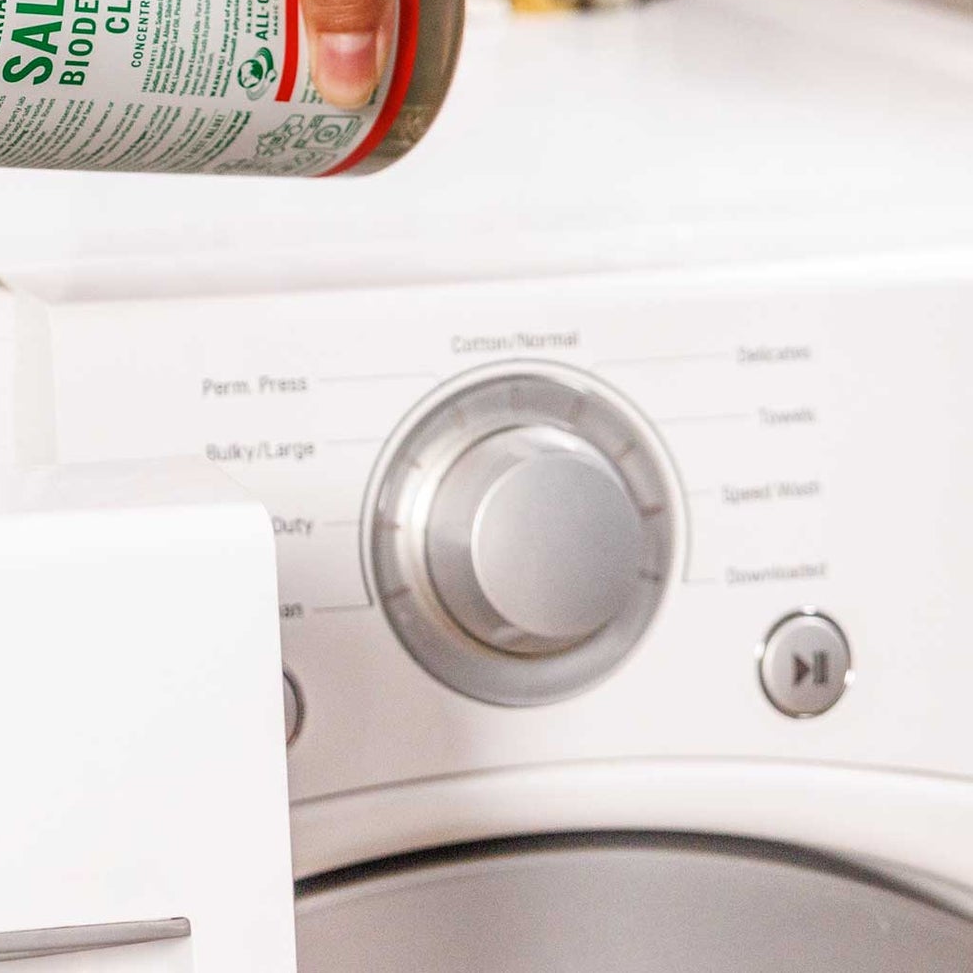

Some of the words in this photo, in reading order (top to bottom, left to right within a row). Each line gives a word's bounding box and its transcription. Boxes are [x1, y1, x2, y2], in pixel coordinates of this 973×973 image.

[223, 8, 230, 18] of
[222, 18, 230, 33] out
[219, 32, 230, 53] Keep
[226, 36, 237, 67] Consult
[202, 377, 252, 396] Perm.
[258, 374, 307, 393] Press
[206, 440, 315, 463] Bulky/Large
